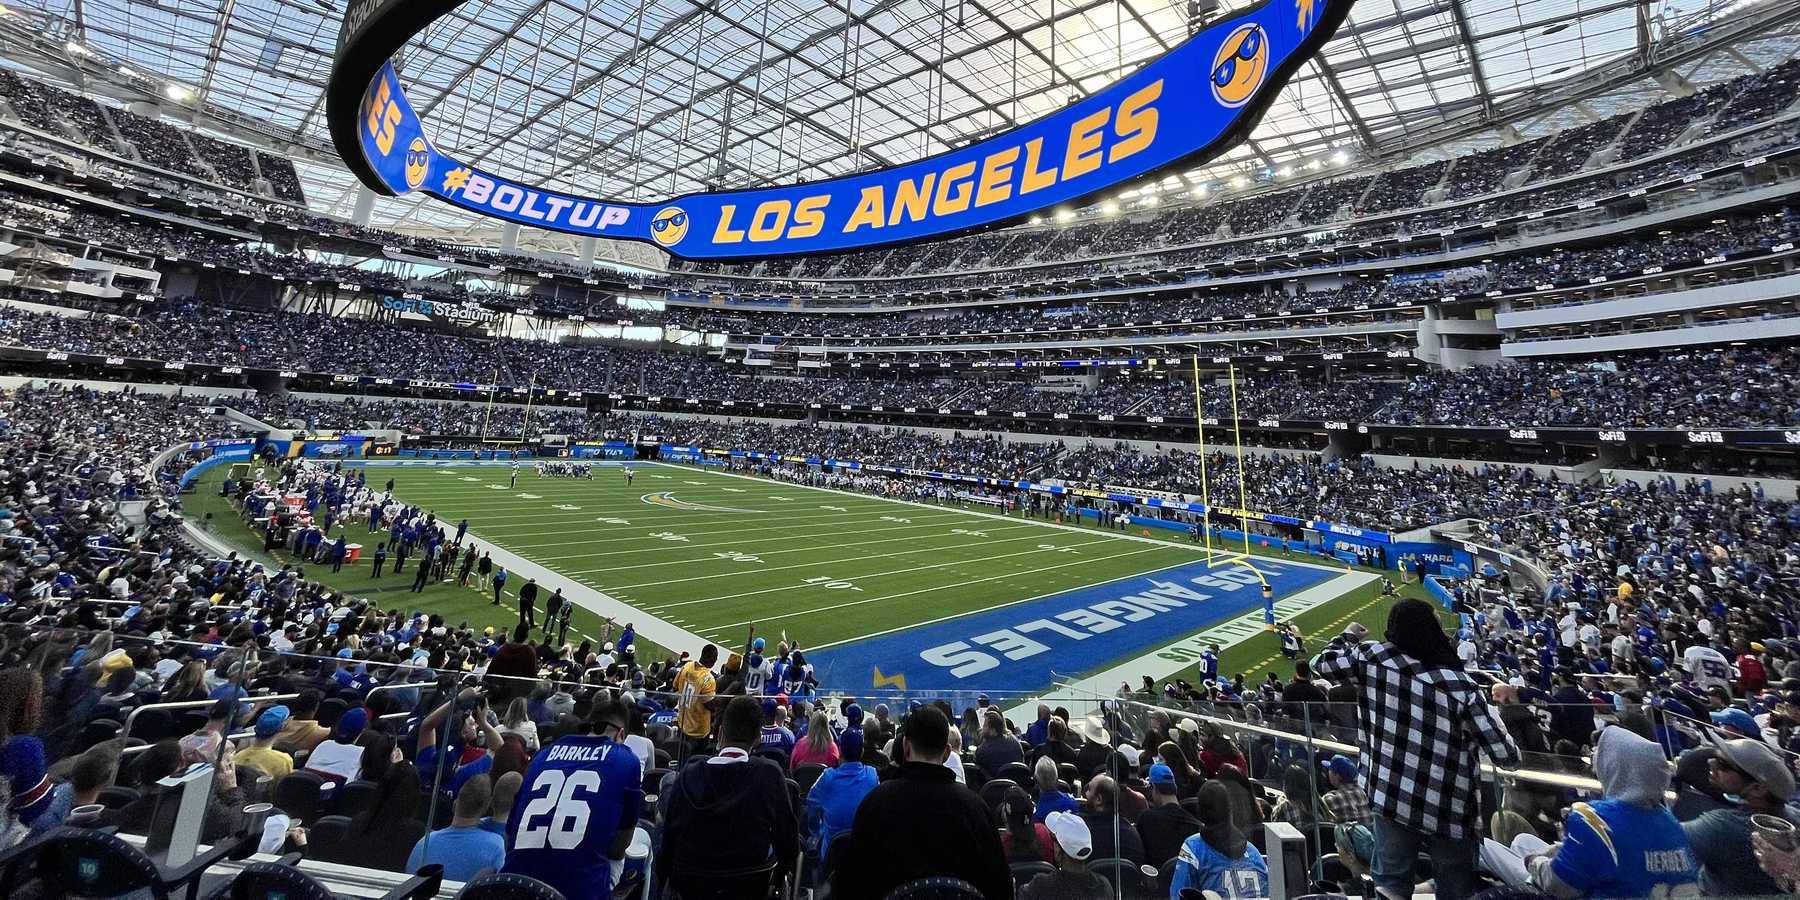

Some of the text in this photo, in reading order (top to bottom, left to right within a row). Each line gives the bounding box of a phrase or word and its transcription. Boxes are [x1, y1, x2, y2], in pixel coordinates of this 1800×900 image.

[712, 79, 1164, 244] LOS ANGELES
[442, 167, 630, 230] #BOLTUP
[383, 295, 494, 322] SoFi Stadium
[1688, 431, 1713, 443] SoFi
[1785, 431, 1800, 443] So
[1232, 510, 1263, 520] ANGELES
[802, 575, 853, 589] 10
[919, 561, 1286, 679] LOS ANGELES
[1157, 648, 1200, 662] US
[546, 744, 612, 762] BARKLEY
[514, 769, 601, 850] 26
[81, 864, 96, 875] 10
